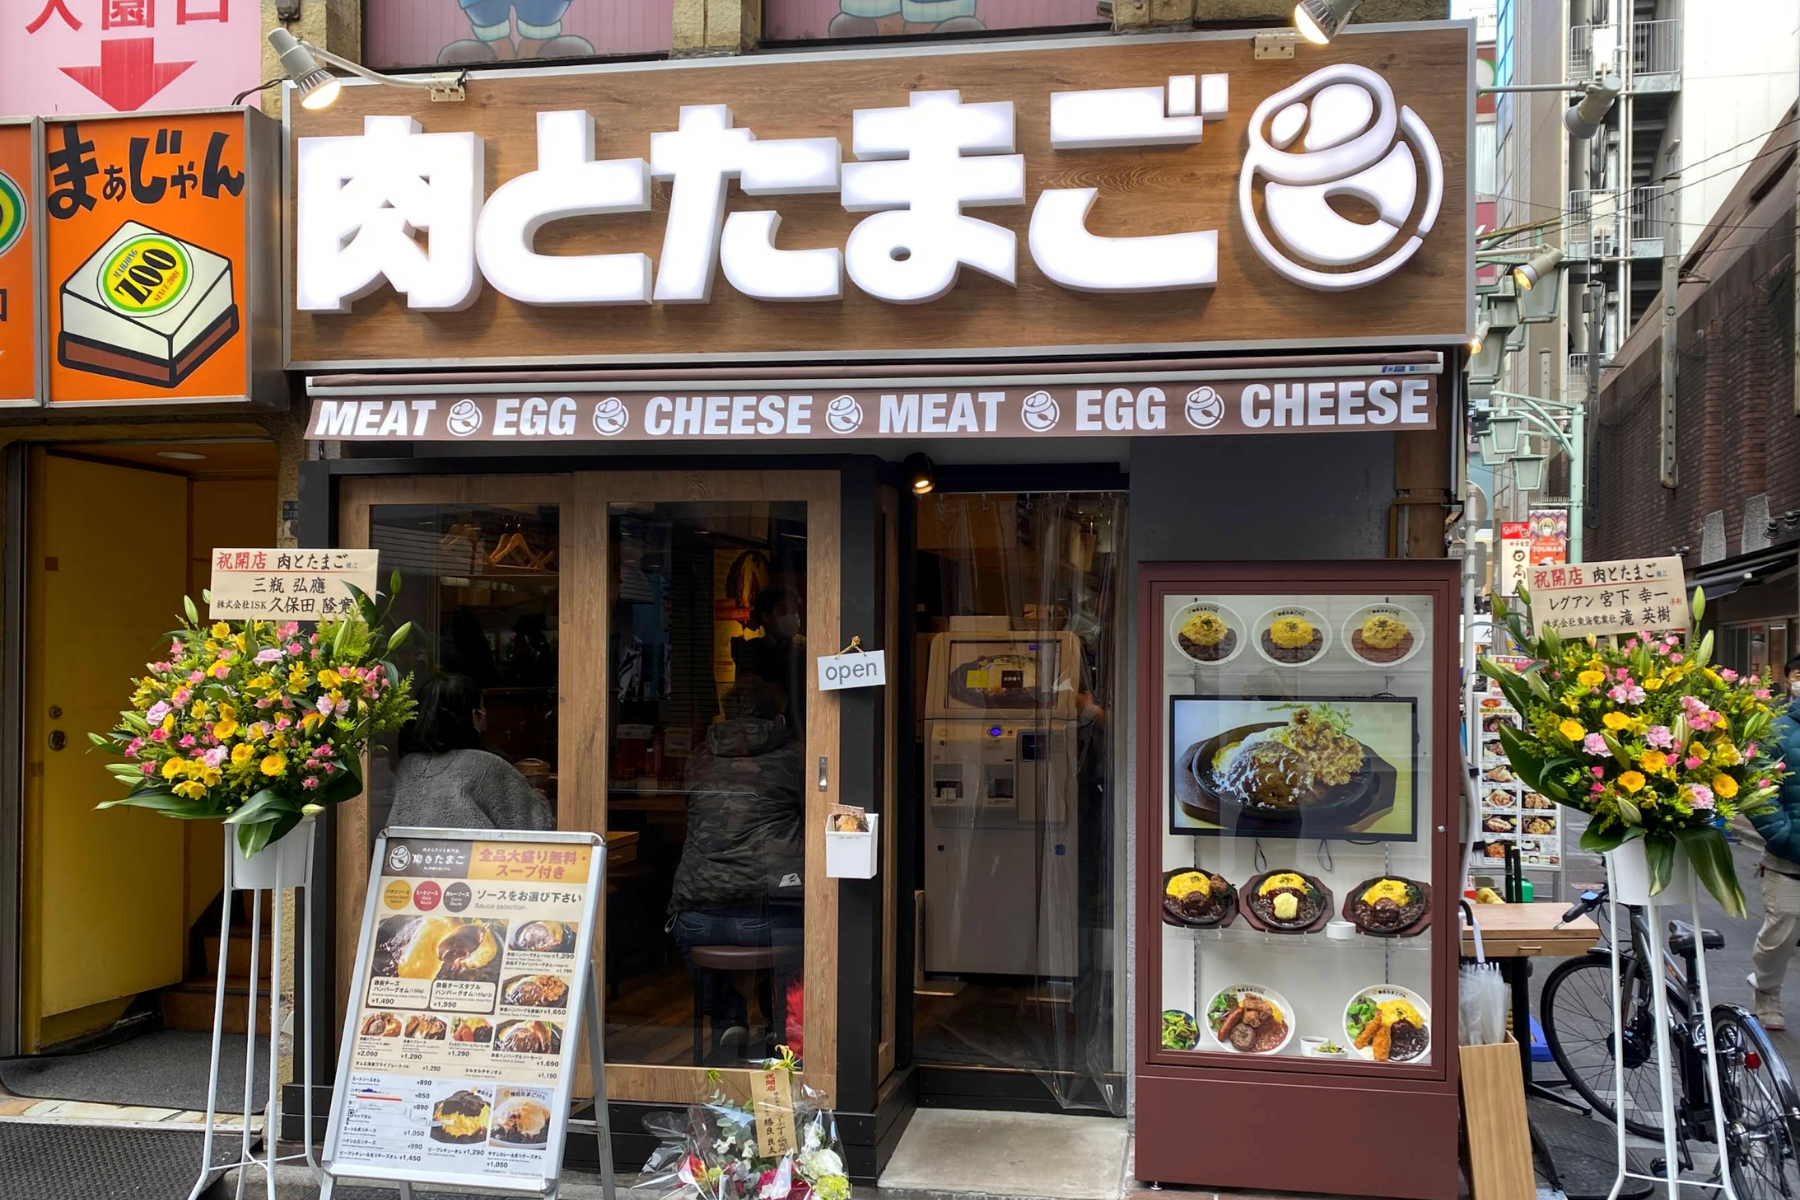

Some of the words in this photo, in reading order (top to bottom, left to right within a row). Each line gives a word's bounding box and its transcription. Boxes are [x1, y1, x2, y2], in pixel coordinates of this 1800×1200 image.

[47, 122, 245, 219] まぁじゃん
[297, 73, 1230, 314] 肉とたまご
[113, 248, 138, 279] MAHJONG
[114, 248, 177, 305] ZOO
[313, 400, 436, 436] MEAT
[492, 397, 577, 436] EGG
[644, 396, 813, 436] CHEESE
[878, 391, 1006, 434] MEAT
[1076, 387, 1167, 432] EGG
[1240, 379, 1430, 428] CHEESE
[216, 551, 268, 570] 祝開店
[277, 553, 349, 571] 肉とたまご
[252, 577, 285, 594] 三瓶
[1533, 567, 1583, 588] 祝開店
[1592, 563, 1657, 583] 肉とたまご
[268, 597, 316, 614] 久保田
[1549, 596, 1595, 611] レグアン
[1600, 589, 1630, 608] 宮下
[1638, 587, 1669, 604] 幸一
[1642, 606, 1671, 624] 英樹
[825, 661, 877, 684] open
[495, 864, 566, 880] スープ付き
[477, 890, 582, 904] ソースをお選び下さい
